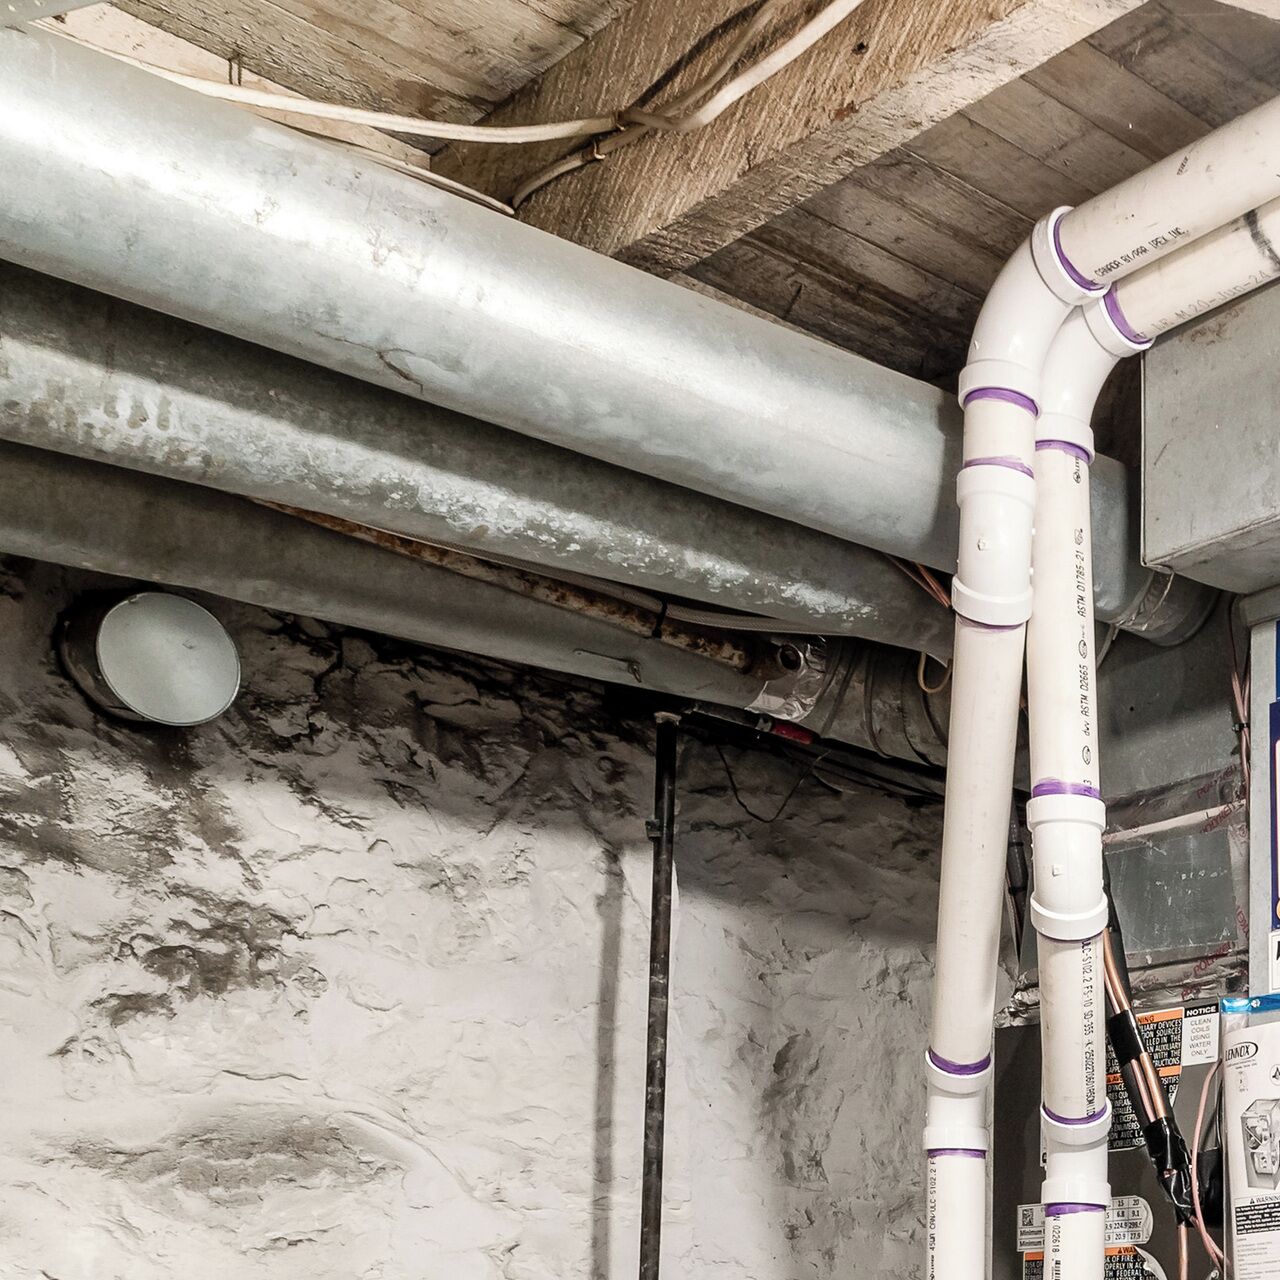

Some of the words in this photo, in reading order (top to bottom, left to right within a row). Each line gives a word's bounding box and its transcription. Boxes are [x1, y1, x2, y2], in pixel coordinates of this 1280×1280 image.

[1094, 260, 1125, 279] CANADA
[1121, 245, 1150, 266] BY/PAR
[1148, 235, 1169, 252] IPEX
[1075, 550, 1086, 591] D1785-21
[1077, 592, 1086, 617] ASTM
[1079, 664, 1089, 691] D2665
[1080, 692, 1090, 717] ASTM
[1186, 1005, 1217, 1017] NOTICE
[1157, 1019, 1182, 1030] DEVICES
[1190, 1018, 1212, 1027] CLEAN
[1156, 1027, 1182, 1037] SOURCES
[1190, 1026, 1211, 1034] COILS
[1170, 1034, 1182, 1043] THE
[1190, 1034, 1211, 1042] USING
[1154, 1041, 1182, 1052] AUXILIARY
[1189, 1040, 1212, 1049] WATER
[1153, 1051, 1169, 1060] WITH
[1170, 1048, 1182, 1057] THE
[1224, 1044, 1251, 1062] LENNOX
[1117, 1199, 1125, 1207] 15
[1019, 1228, 1042, 1237] Minimum
[1019, 1239, 1042, 1247] Minimum
[1051, 1225, 1060, 1253] 022618
[1116, 1269, 1142, 1277] FEDERAL
